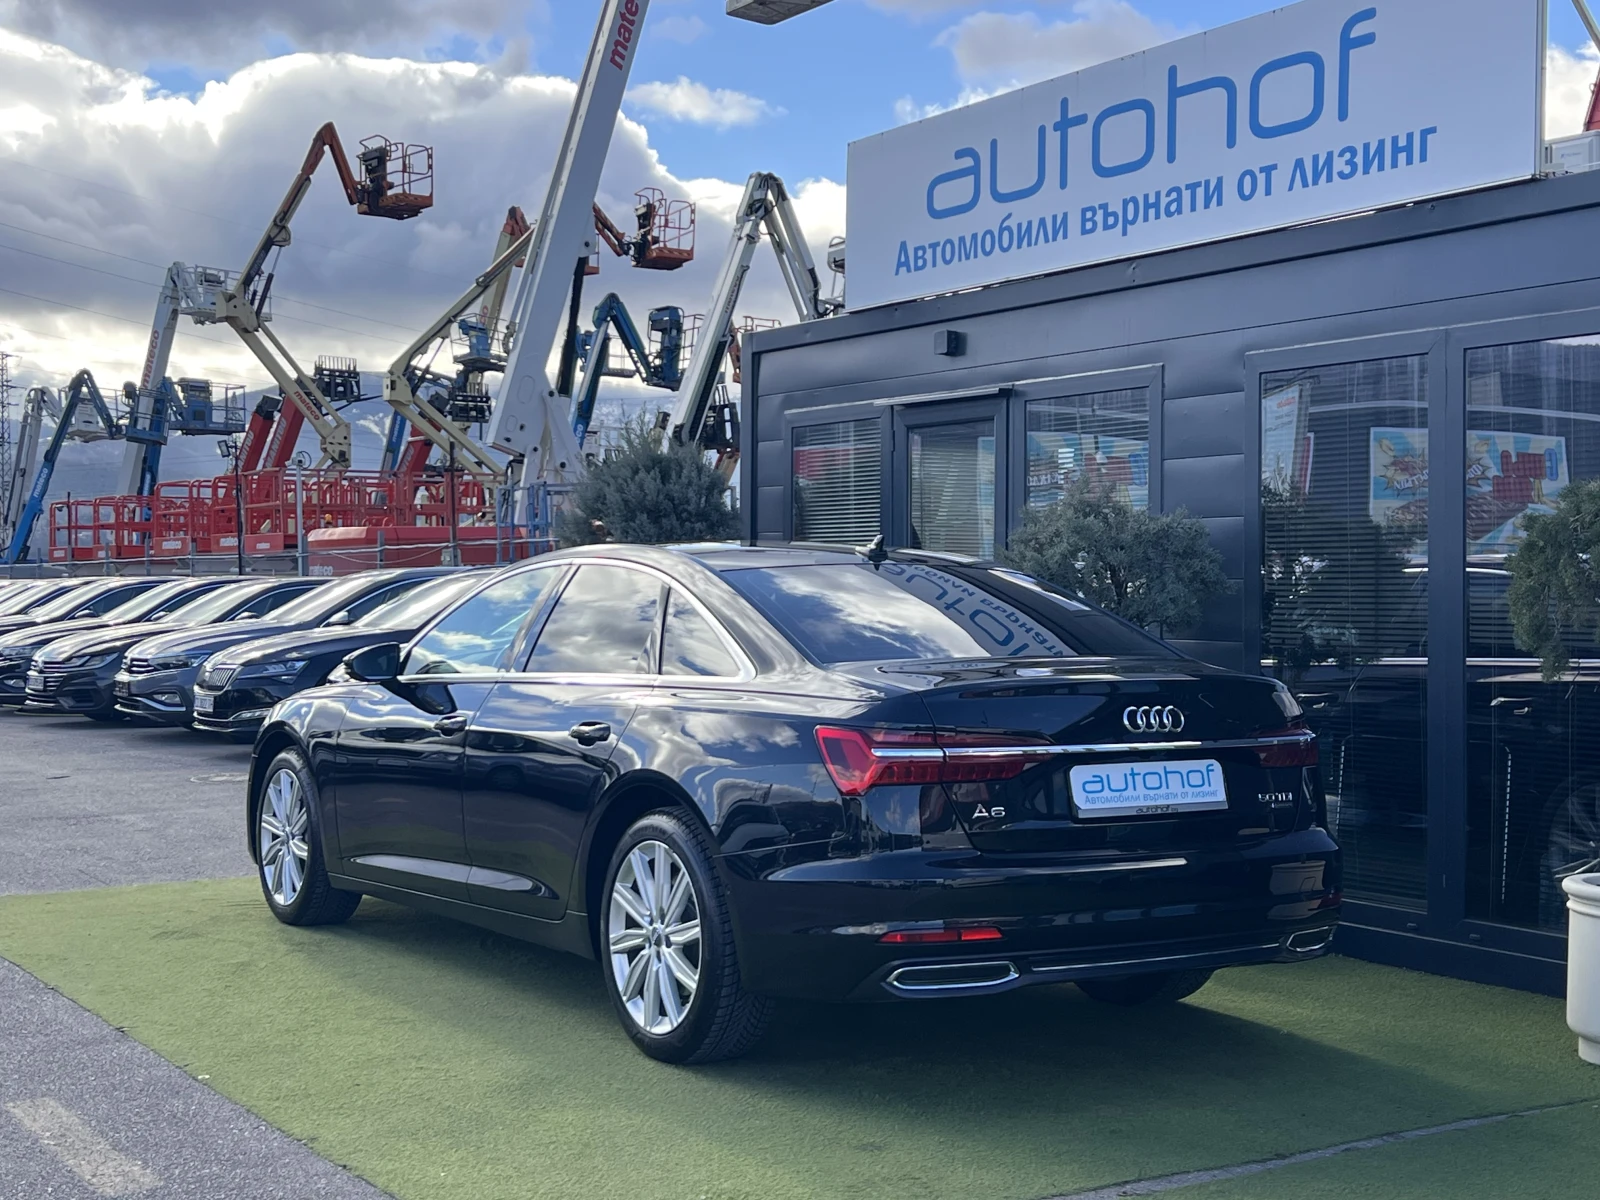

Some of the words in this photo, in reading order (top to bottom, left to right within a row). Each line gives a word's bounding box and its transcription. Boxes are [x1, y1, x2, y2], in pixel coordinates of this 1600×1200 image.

[926, 7, 1377, 220] autohof
[895, 213, 1068, 276] Автомобили
[1080, 176, 1223, 237] върнати
[1237, 163, 1278, 202] от
[1288, 126, 1437, 192] лизинг
[294, 390, 320, 421] mateco
[33, 467, 49, 498] mateco
[1082, 763, 1215, 794] autohof
[972, 803, 1006, 819] A6
[1085, 793, 1140, 805] Автомобили
[1143, 791, 1178, 802] върнати
[1181, 791, 1189, 800] от
[1191, 789, 1219, 799] лизинг
